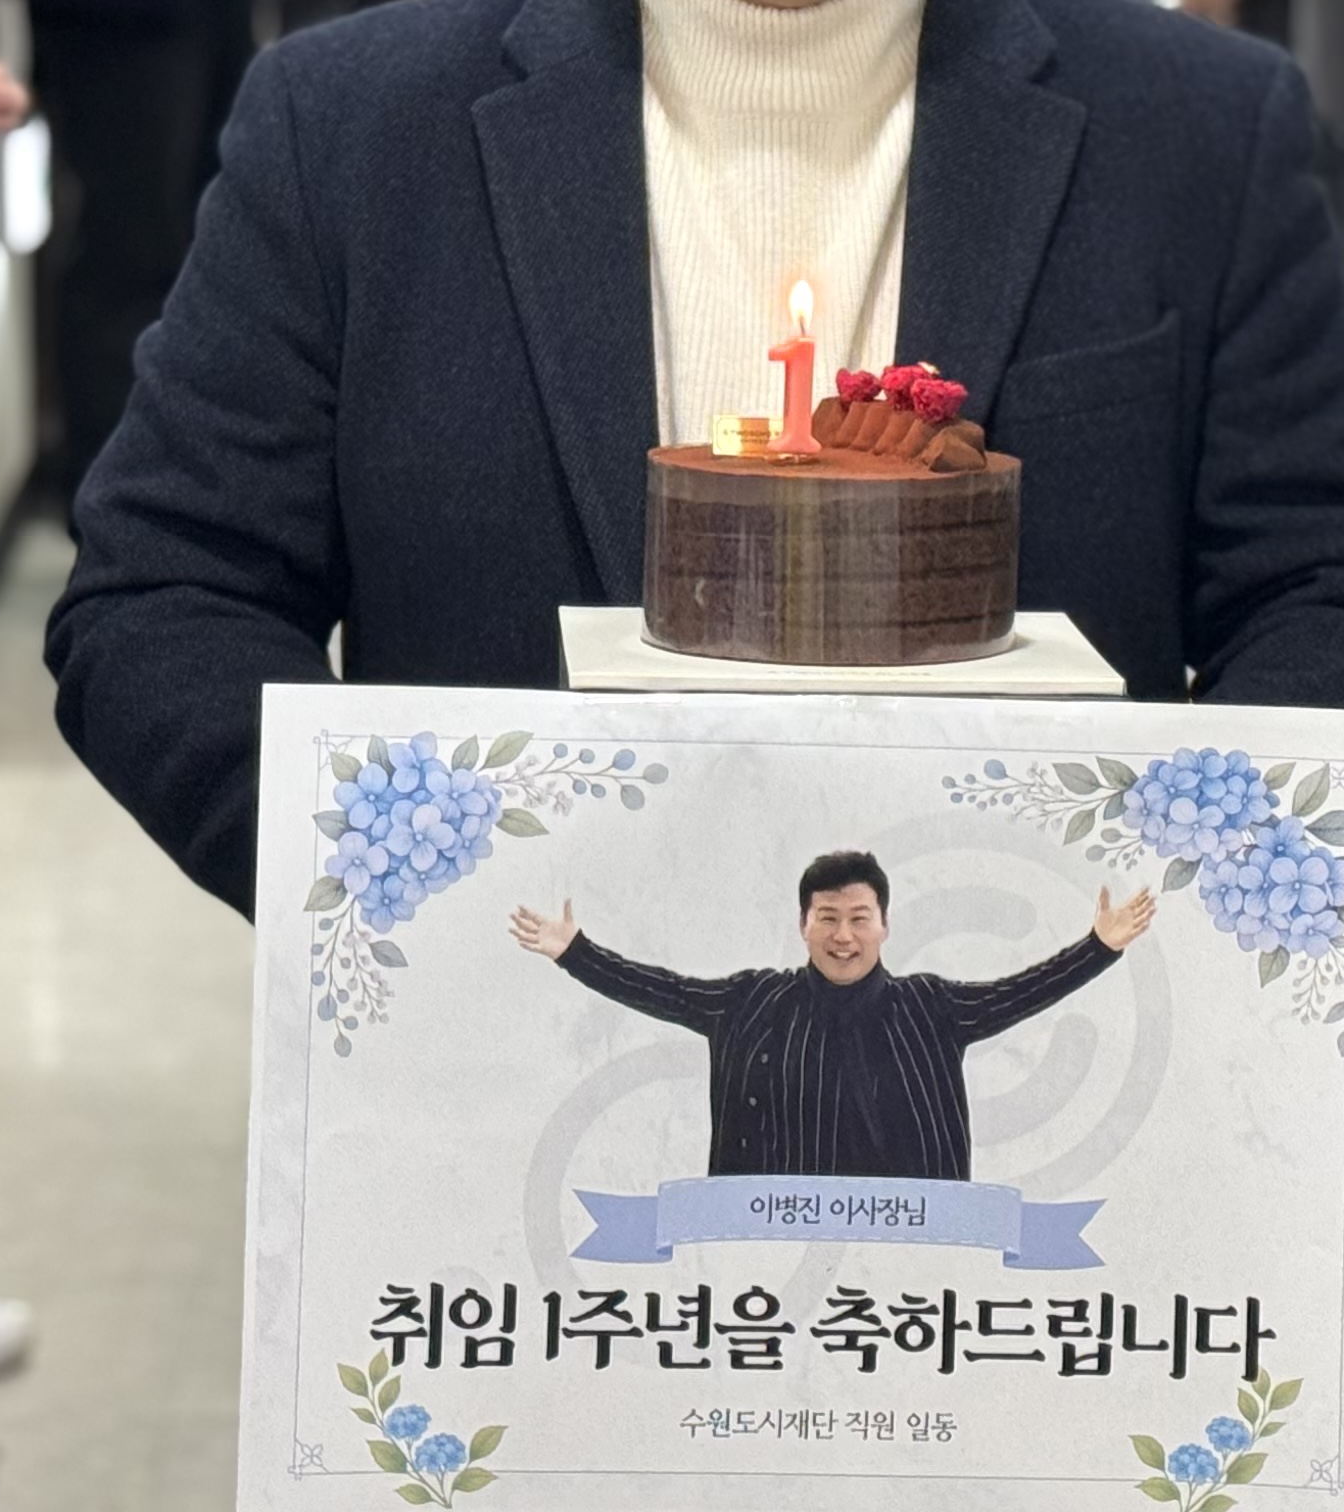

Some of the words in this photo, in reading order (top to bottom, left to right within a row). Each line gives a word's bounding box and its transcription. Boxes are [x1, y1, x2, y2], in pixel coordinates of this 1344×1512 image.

[767, 336, 822, 454] 1
[749, 1192, 821, 1225] 이병진
[829, 1194, 927, 1227] 이사장님
[370, 1282, 518, 1370] 취임
[542, 1284, 796, 1371] 1주년을
[808, 1286, 1277, 1383] 축하드립니다
[679, 1407, 839, 1440] 수원도시재단
[844, 1409, 895, 1441] 직원
[906, 1411, 958, 1443] 일동
